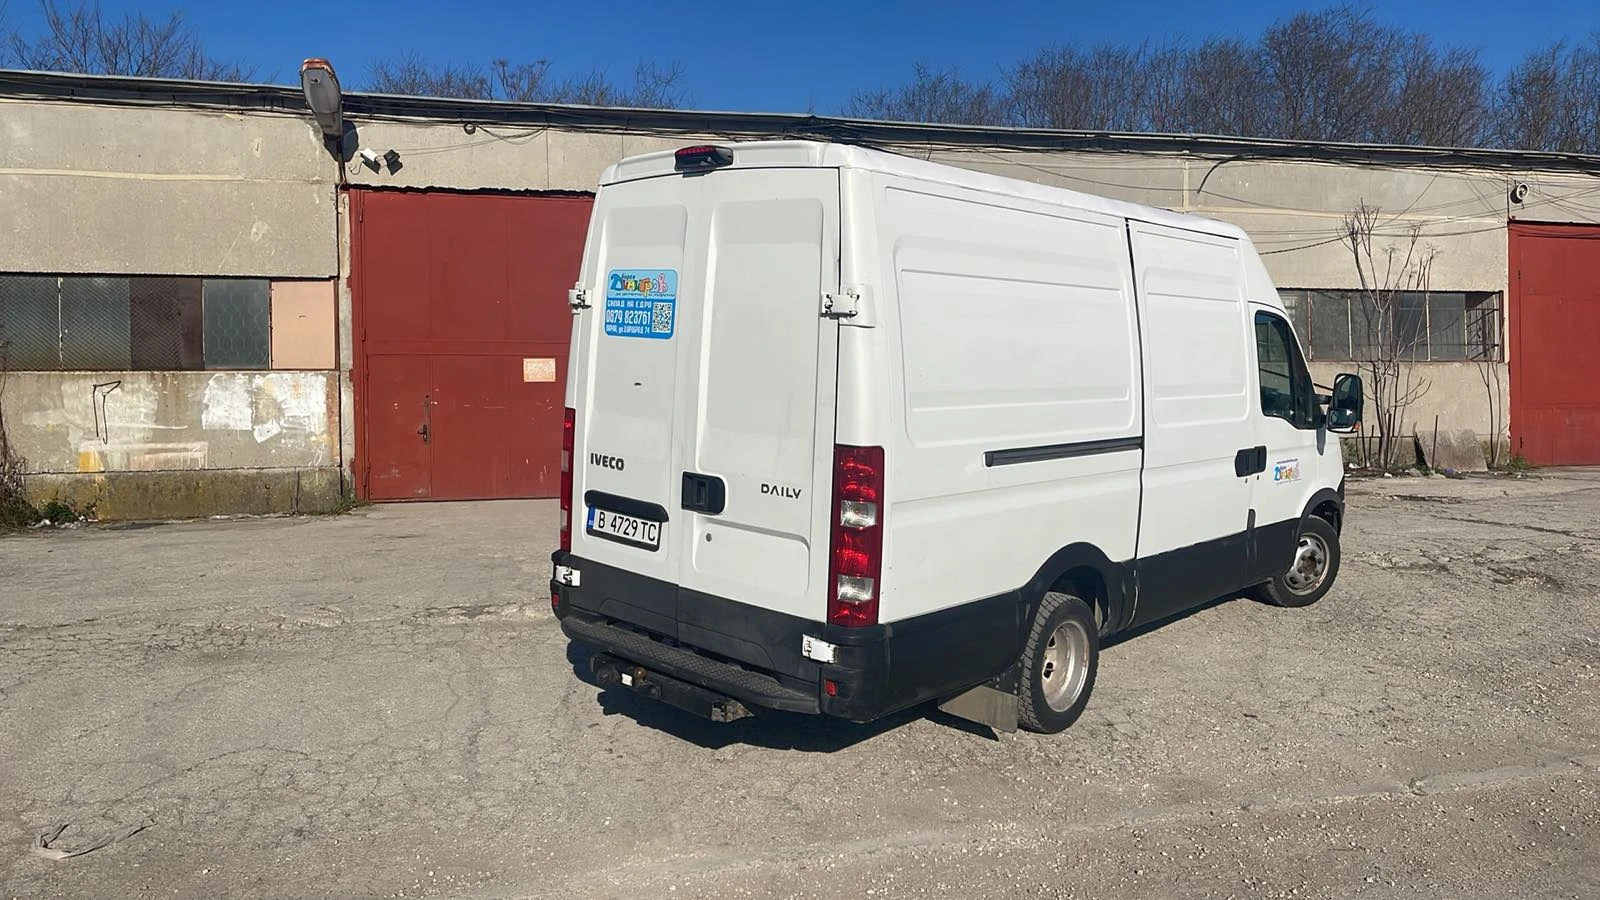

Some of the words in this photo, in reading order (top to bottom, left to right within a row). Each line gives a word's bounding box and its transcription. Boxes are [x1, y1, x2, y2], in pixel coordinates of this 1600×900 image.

[606, 310, 622, 323] 0879
[624, 310, 651, 325] 823761
[590, 452, 624, 471] IVECO
[761, 484, 801, 499] DAILY
[598, 512, 605, 528] B
[611, 515, 638, 537] 4729
[641, 522, 656, 541] TC
